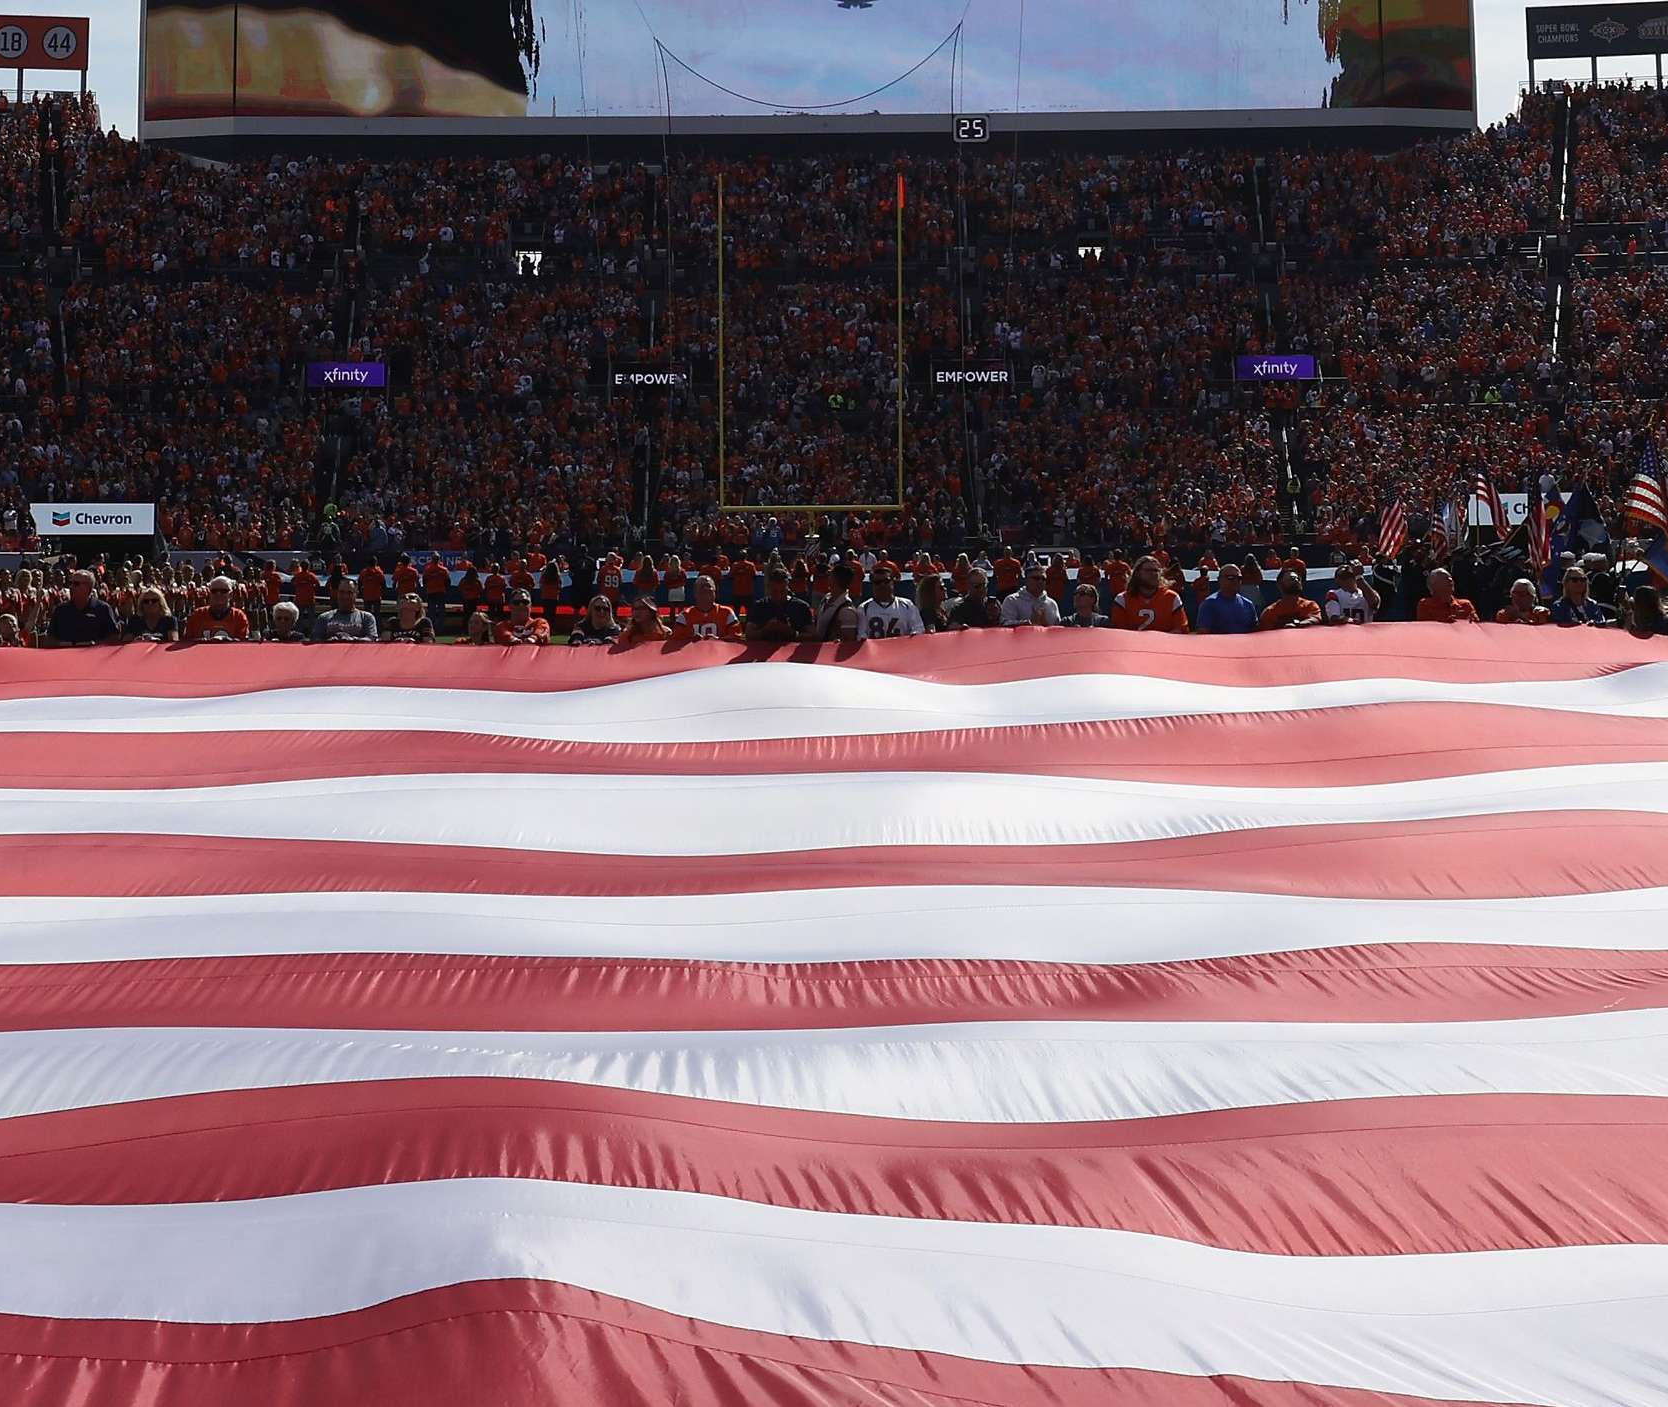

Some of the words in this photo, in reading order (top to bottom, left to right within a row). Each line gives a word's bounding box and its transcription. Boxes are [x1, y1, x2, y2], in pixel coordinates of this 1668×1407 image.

[1535, 23, 1558, 34] SUPER
[1560, 22, 1581, 33] BOWL
[1, 31, 22, 52] 18
[48, 33, 71, 53] 44
[1537, 33, 1580, 45] CHAMPIONS
[959, 119, 984, 138] 25
[1253, 360, 1298, 376] xfinity
[324, 367, 369, 384] xfinity
[615, 373, 687, 385] EPOWE
[936, 371, 1008, 383] EMPOWER
[75, 512, 132, 525] Chevron
[604, 575, 620, 588] 99
[1138, 608, 1155, 631] 2
